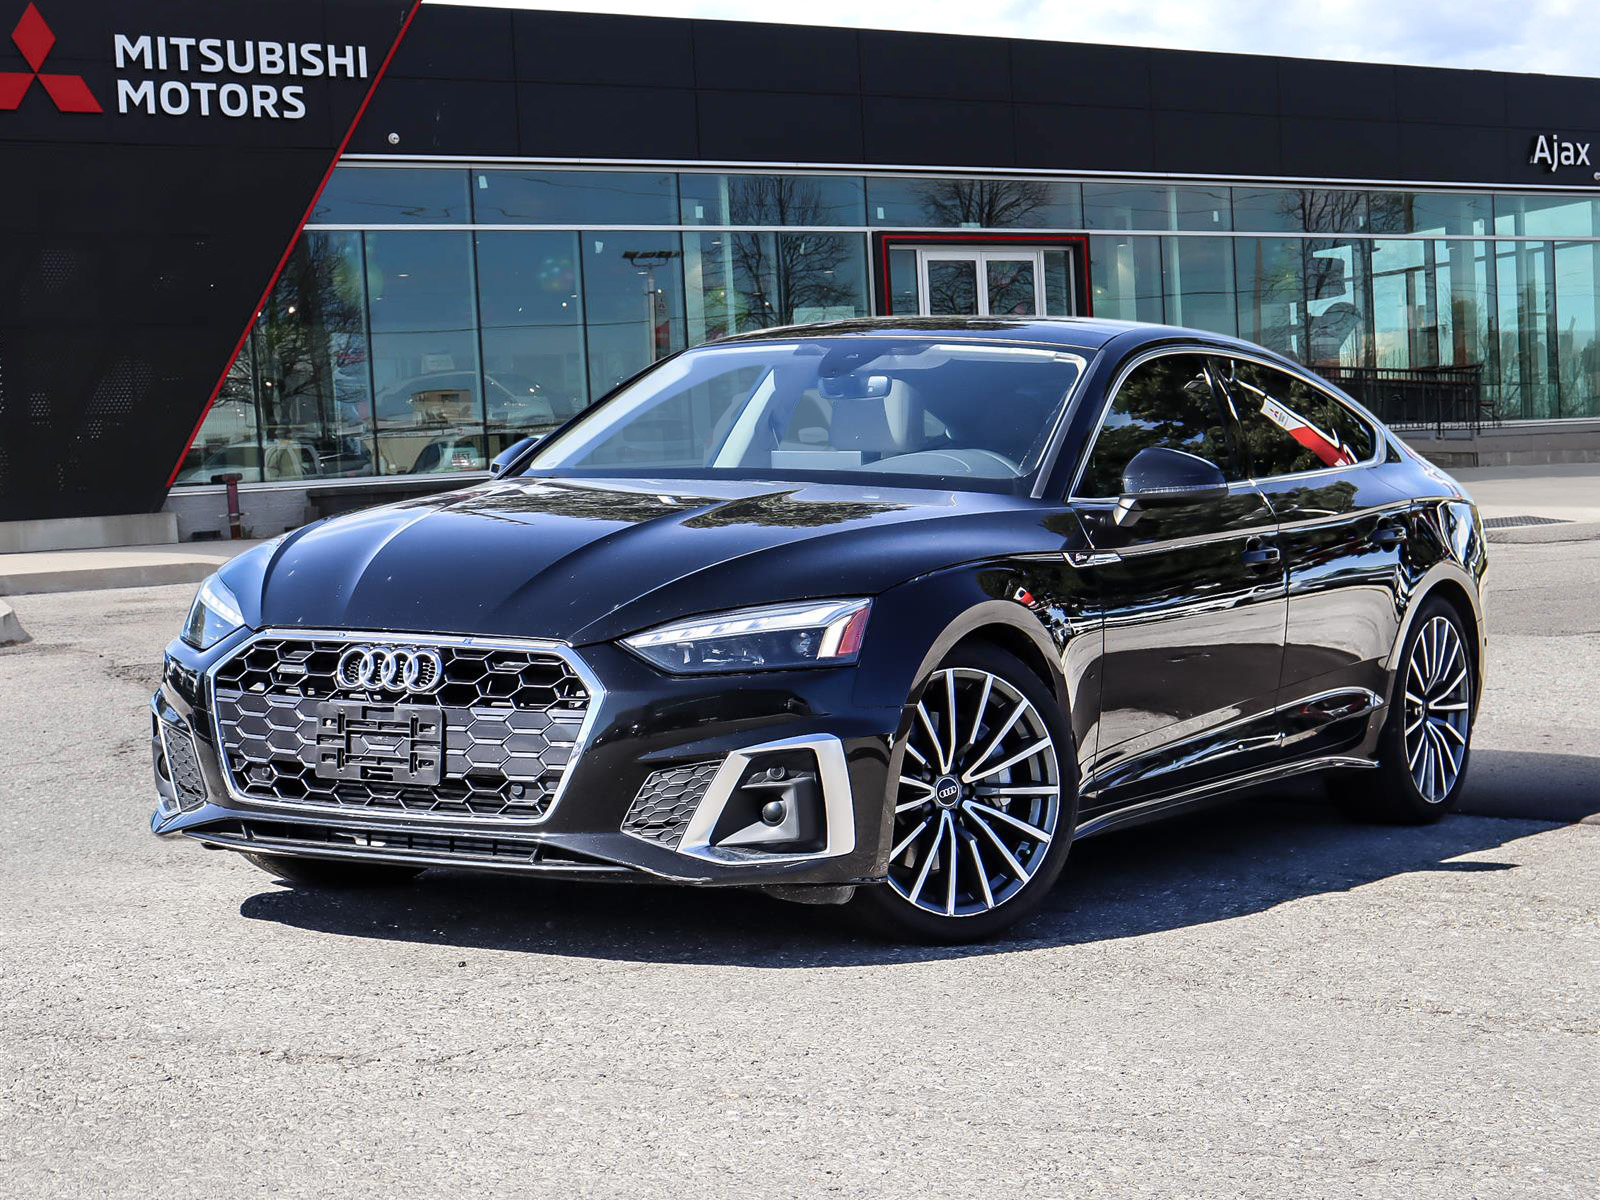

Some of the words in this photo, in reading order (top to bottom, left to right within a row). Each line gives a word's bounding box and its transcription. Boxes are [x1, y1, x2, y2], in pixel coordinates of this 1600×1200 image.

[114, 34, 368, 78] MITSUBISHI
[117, 79, 306, 119] MOTORS
[1533, 134, 1591, 173] Ajax
